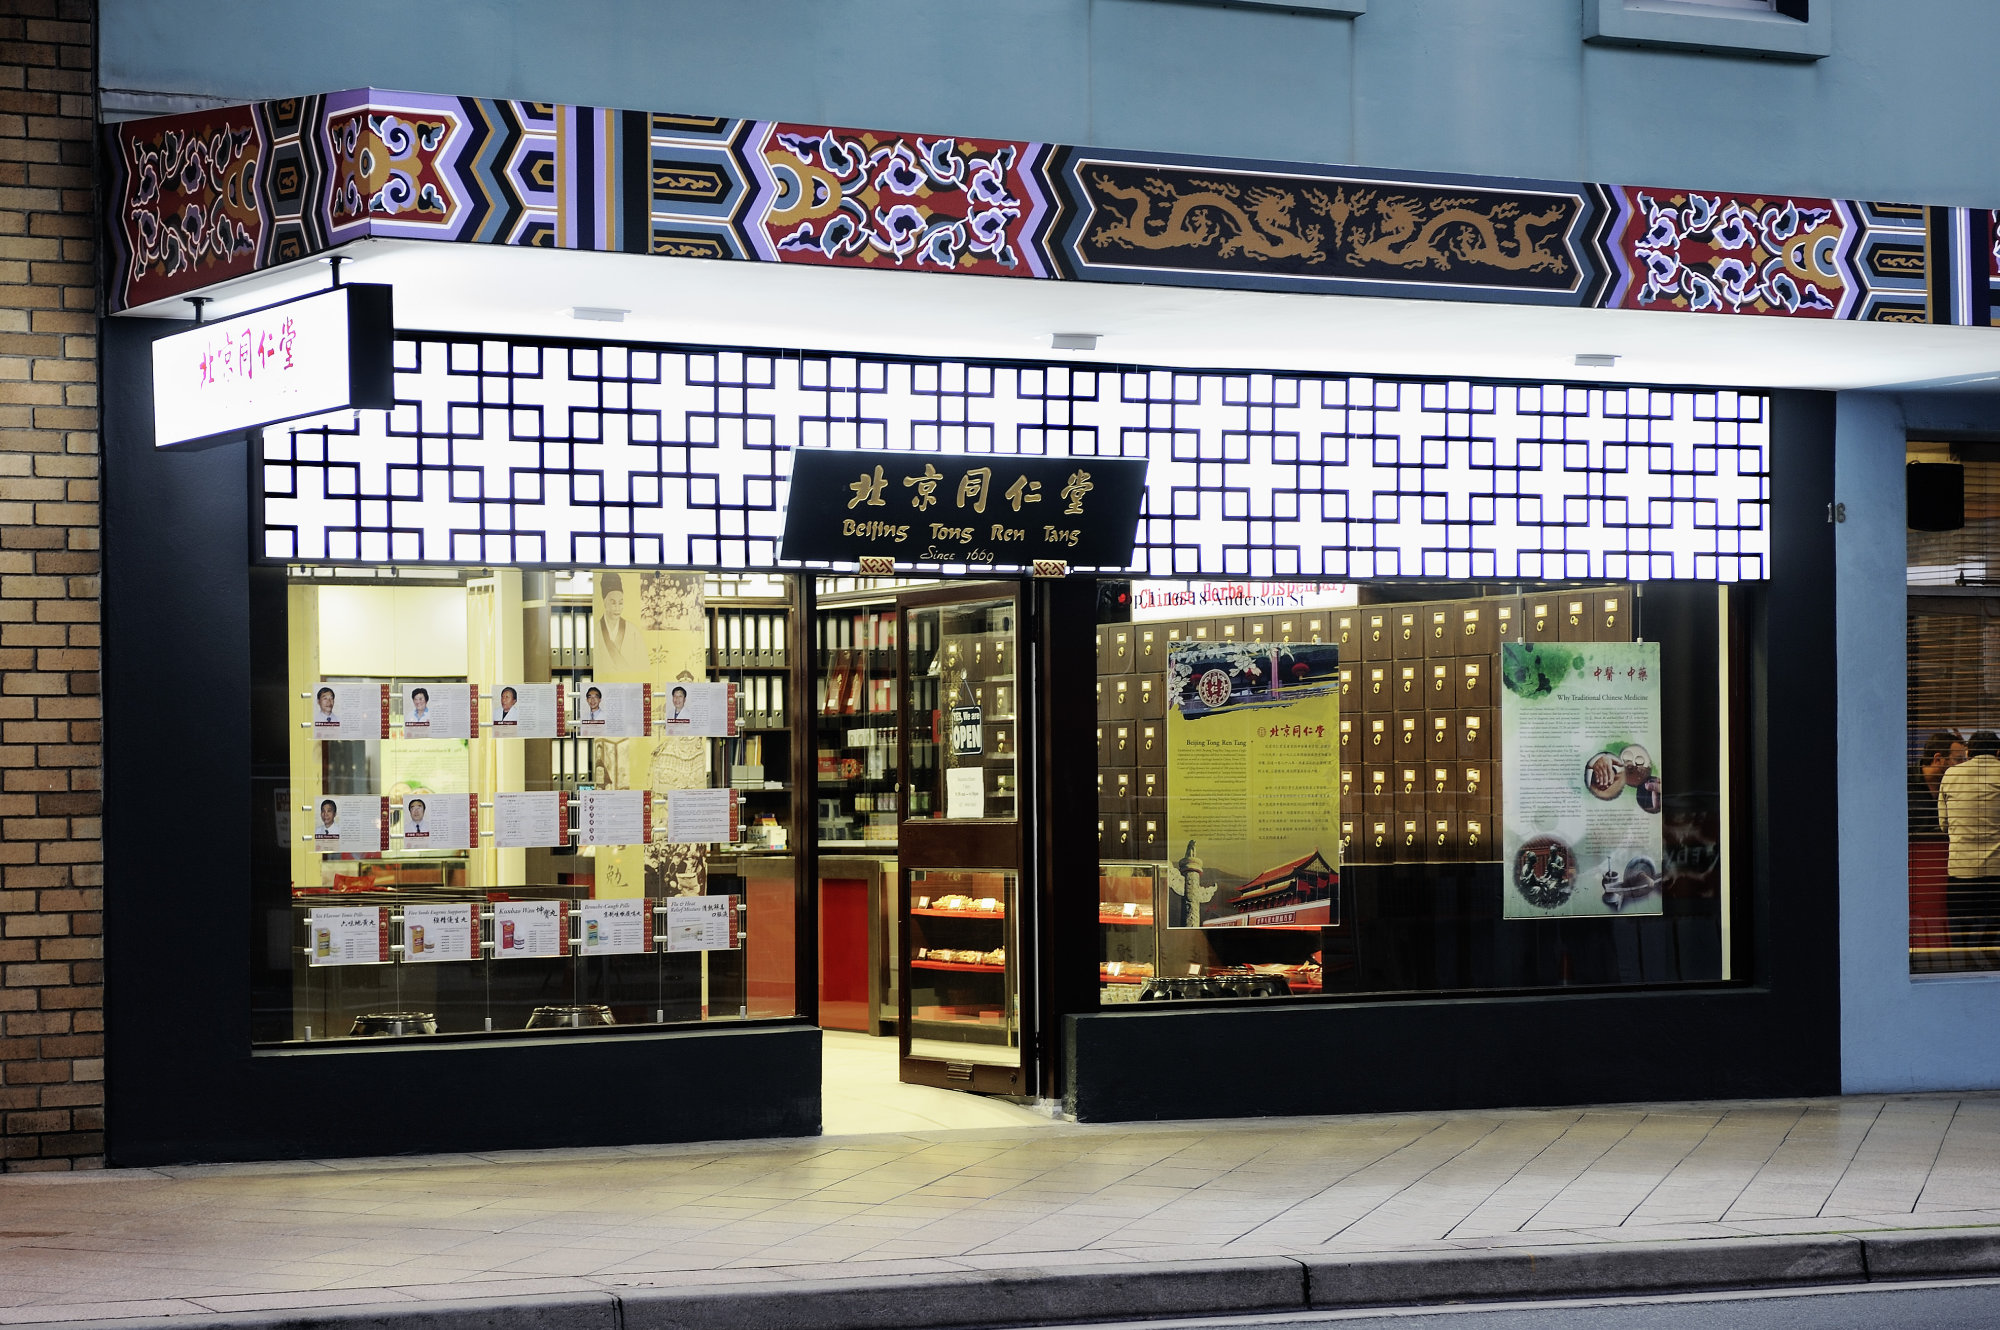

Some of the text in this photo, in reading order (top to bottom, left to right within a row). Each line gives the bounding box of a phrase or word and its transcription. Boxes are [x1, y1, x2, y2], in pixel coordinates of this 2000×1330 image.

[847, 463, 1095, 515] 北京同仁堂
[1827, 502, 1846, 523] 18
[842, 518, 1081, 547] Beijing Tong Ren Tang
[920, 545, 995, 564] Since 1669
[1212, 591, 1284, 606] Anderson
[1290, 594, 1305, 606] St
[1557, 694, 1570, 703] Why
[953, 724, 981, 749] OPEN
[1269, 724, 1325, 738] 北京同仁堂
[1186, 739, 1205, 747] Beijing
